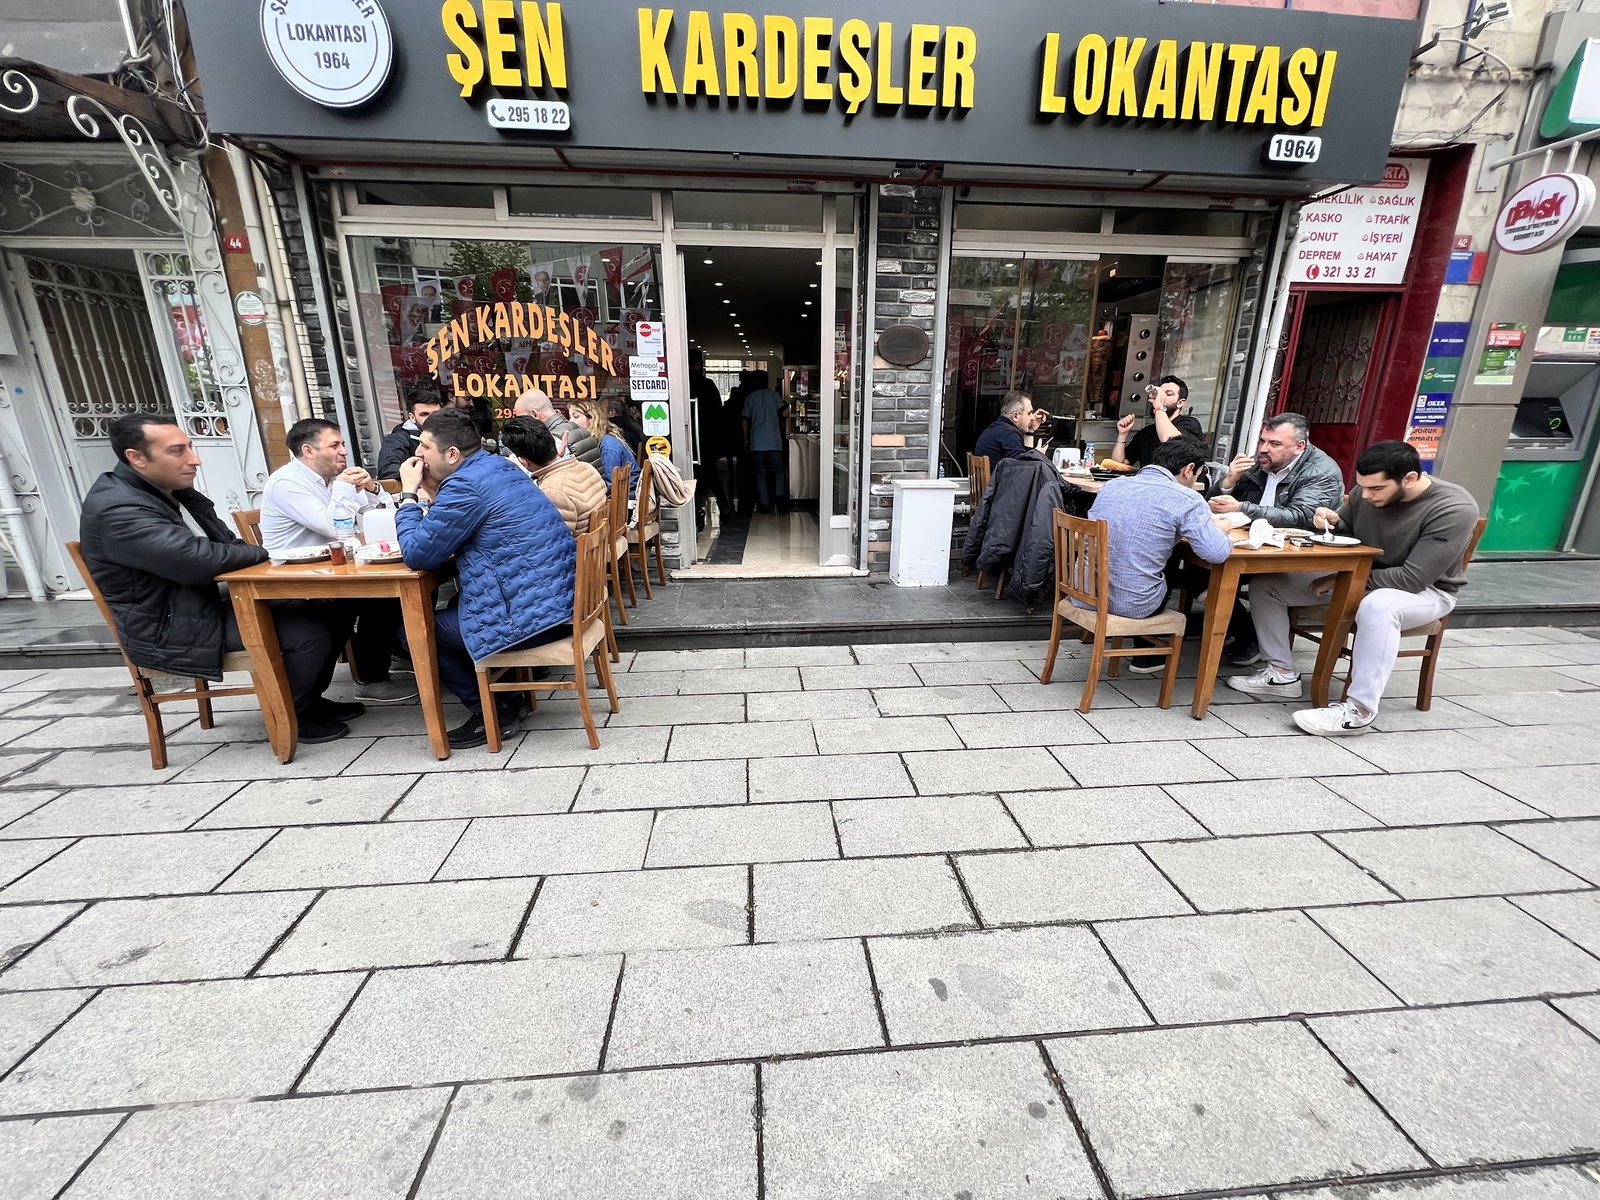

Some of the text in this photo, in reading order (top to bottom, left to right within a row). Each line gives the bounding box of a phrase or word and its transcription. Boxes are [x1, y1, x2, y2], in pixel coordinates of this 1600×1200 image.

[286, 22, 368, 43] LOKANTASI
[314, 51, 350, 69] 1964
[441, 0, 1338, 127] ŞEN KARDEŞLER LOKANTASI
[508, 106, 566, 124] 295 18 22
[1275, 138, 1316, 159] 1964
[1316, 192, 1364, 205] EKLİLİK
[1377, 195, 1415, 206] SAĞLIK
[1305, 212, 1343, 223] KASKO
[1374, 214, 1411, 225] TRAFİK
[229, 237, 243, 249] 44
[1307, 231, 1339, 242] ONUT
[1370, 231, 1403, 245] İŞYERİ
[1298, 250, 1342, 261] DEPREM
[1365, 252, 1398, 262] HAYAT
[1322, 265, 1376, 279] 321 33 21
[426, 301, 617, 380] ŞEN KARDEŞLER
[451, 373, 597, 399] LOKANTASI
[631, 380, 667, 390] SETCARD
[494, 408, 516, 419] 29
